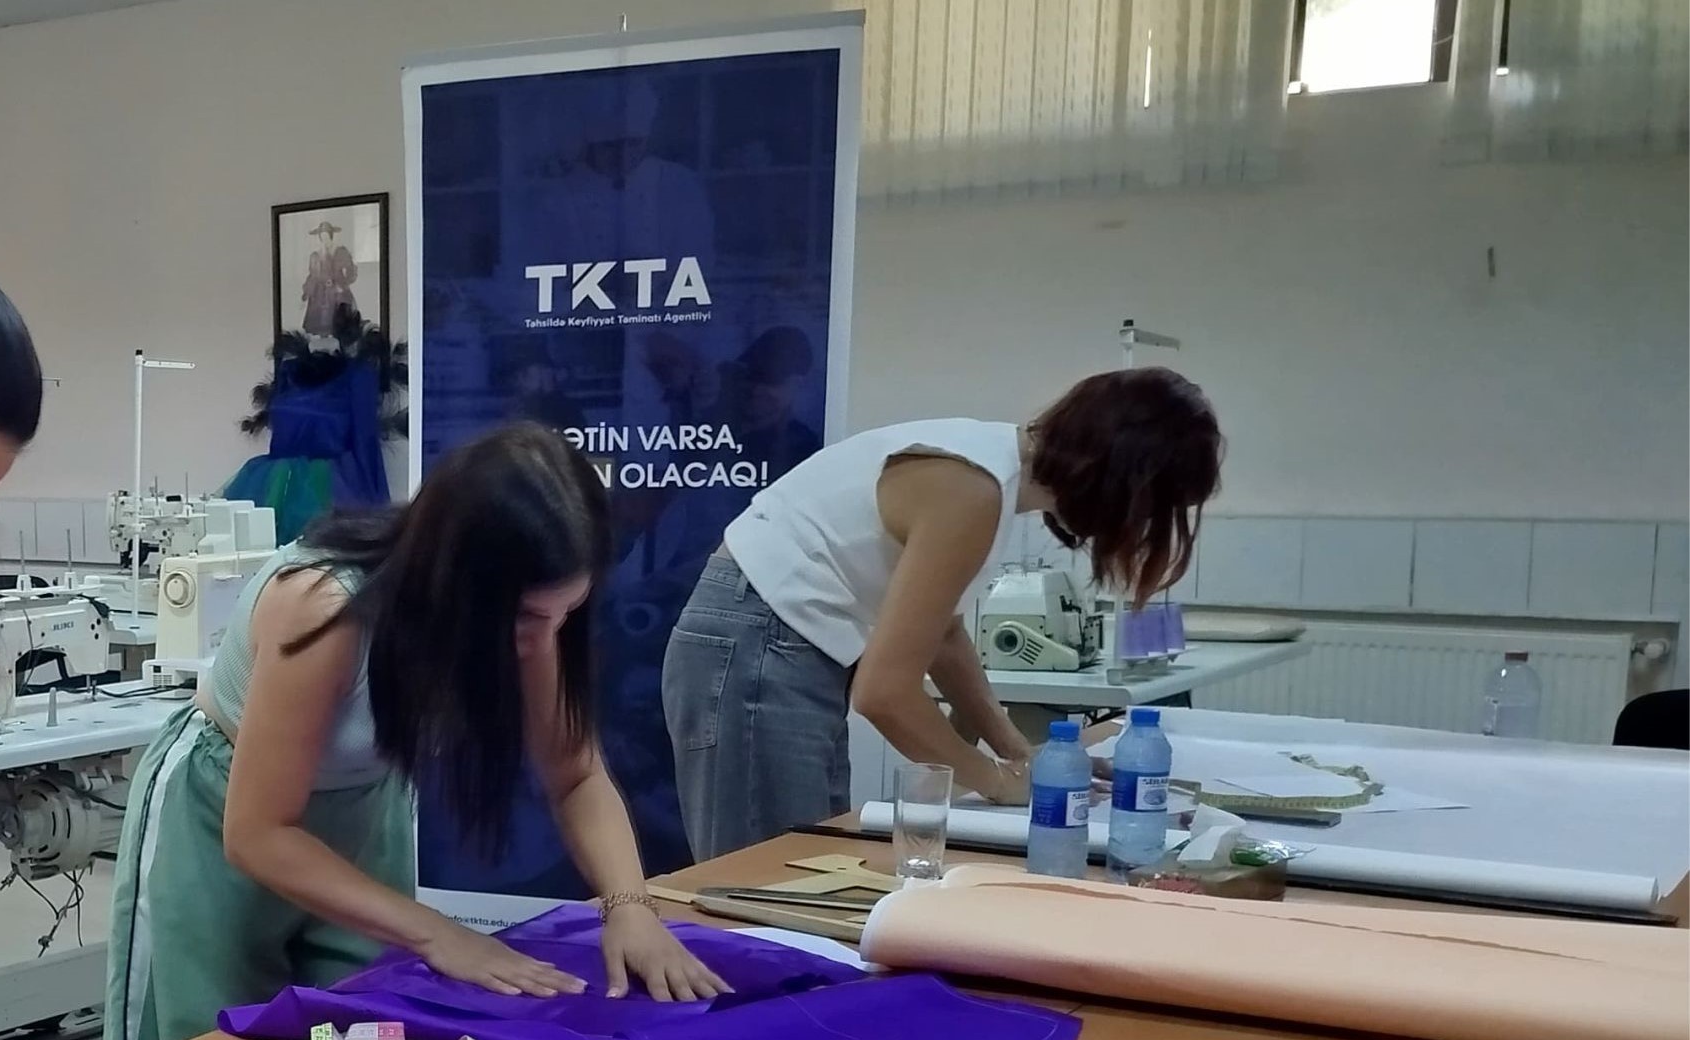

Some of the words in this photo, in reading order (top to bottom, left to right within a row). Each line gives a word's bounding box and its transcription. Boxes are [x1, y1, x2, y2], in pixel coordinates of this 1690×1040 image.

[525, 256, 712, 313] TKTA
[524, 319, 566, 328] Təhsildə
[568, 317, 615, 328] Keyfiyyət
[664, 311, 712, 323] Agentliyi
[560, 422, 629, 452] ƏTİN
[637, 424, 743, 454] VARSA,
[619, 461, 768, 489] OLACAQ!
